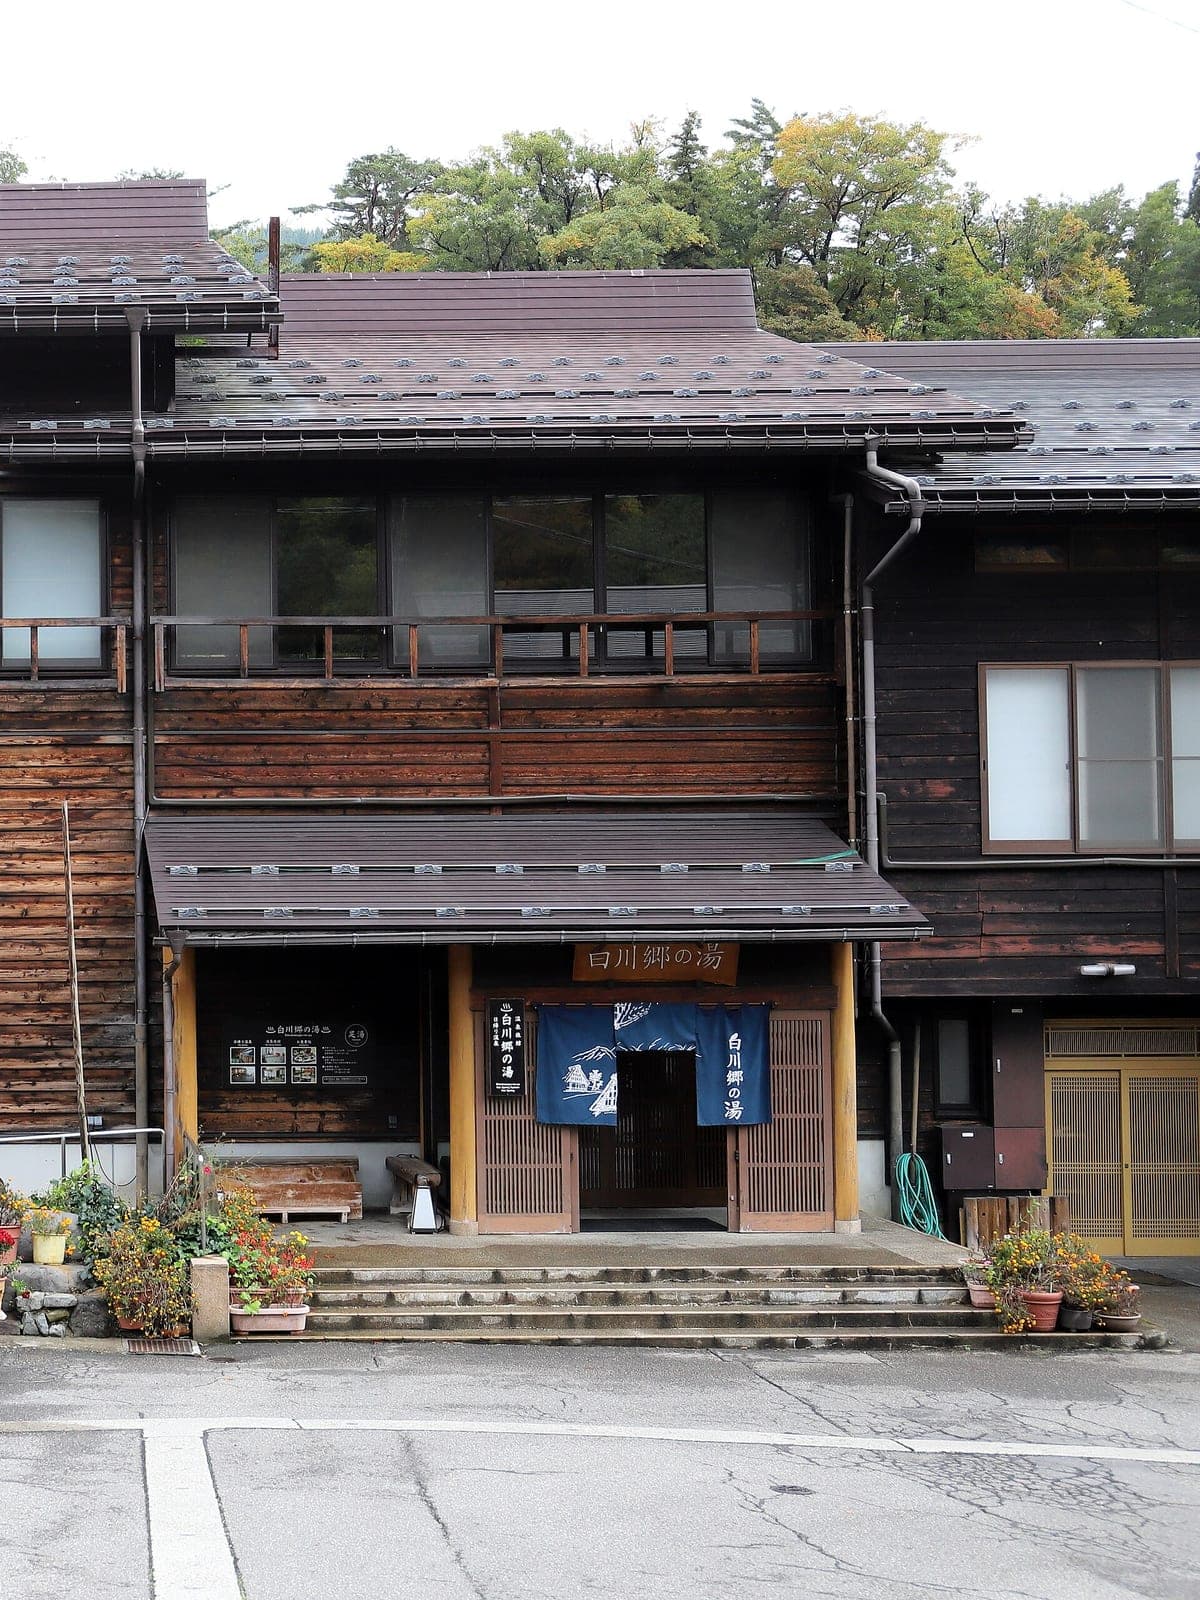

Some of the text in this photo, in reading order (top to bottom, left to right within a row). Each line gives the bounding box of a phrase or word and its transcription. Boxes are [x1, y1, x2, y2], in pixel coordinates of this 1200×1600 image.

[588, 942, 725, 970] 白川郷の湯
[277, 1025, 320, 1034] 白川郷の湯
[501, 1013, 514, 1079] 白川郷の湯
[724, 1032, 745, 1121] 白川郷の湯
